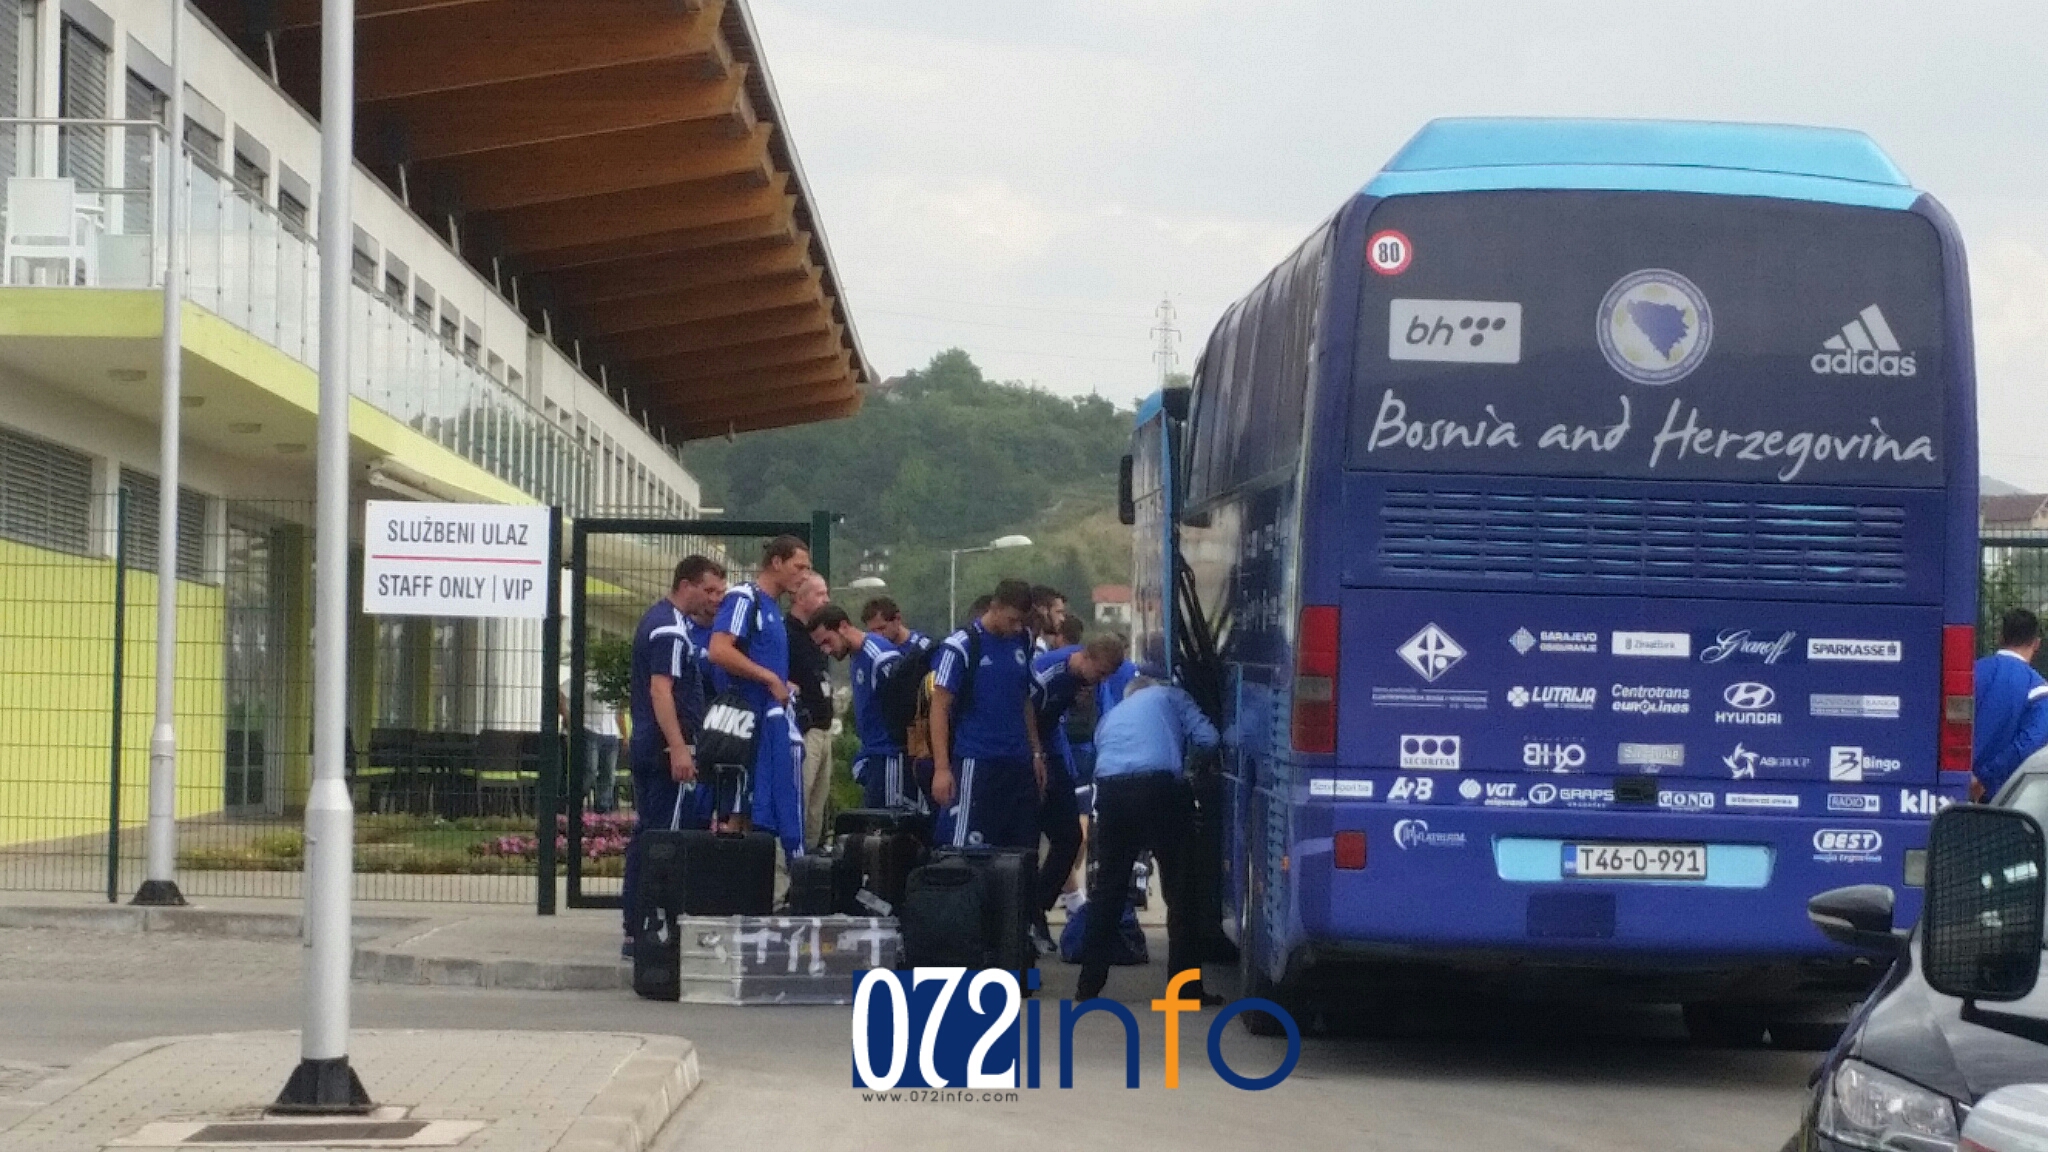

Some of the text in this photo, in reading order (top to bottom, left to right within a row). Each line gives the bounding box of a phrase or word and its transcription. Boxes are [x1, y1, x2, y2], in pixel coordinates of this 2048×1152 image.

[1378, 241, 1400, 263] 80
[1405, 315, 1452, 347] bh
[1811, 349, 1917, 377] adidas
[1367, 389, 1937, 483] Bosnia and Herzegovina
[387, 515, 529, 546] SLUŽBENI ULAZ
[378, 573, 533, 600] STAFF ONLY VIP
[1540, 631, 1597, 642] SARAJEVO
[1812, 642, 1886, 656] SPARKASSE
[1531, 686, 1597, 703] LUTRIJA
[1612, 683, 1690, 700] Centrotrans
[702, 704, 755, 738] NIKE
[1715, 711, 1782, 724] HYUNDAI
[1404, 756, 1456, 767] SECURITAS
[1862, 756, 1901, 772] Bingo
[1486, 783, 1517, 797] VGT
[1659, 792, 1713, 807] GONG
[1831, 796, 1864, 808] RADIO
[1821, 833, 1875, 849] BEST
